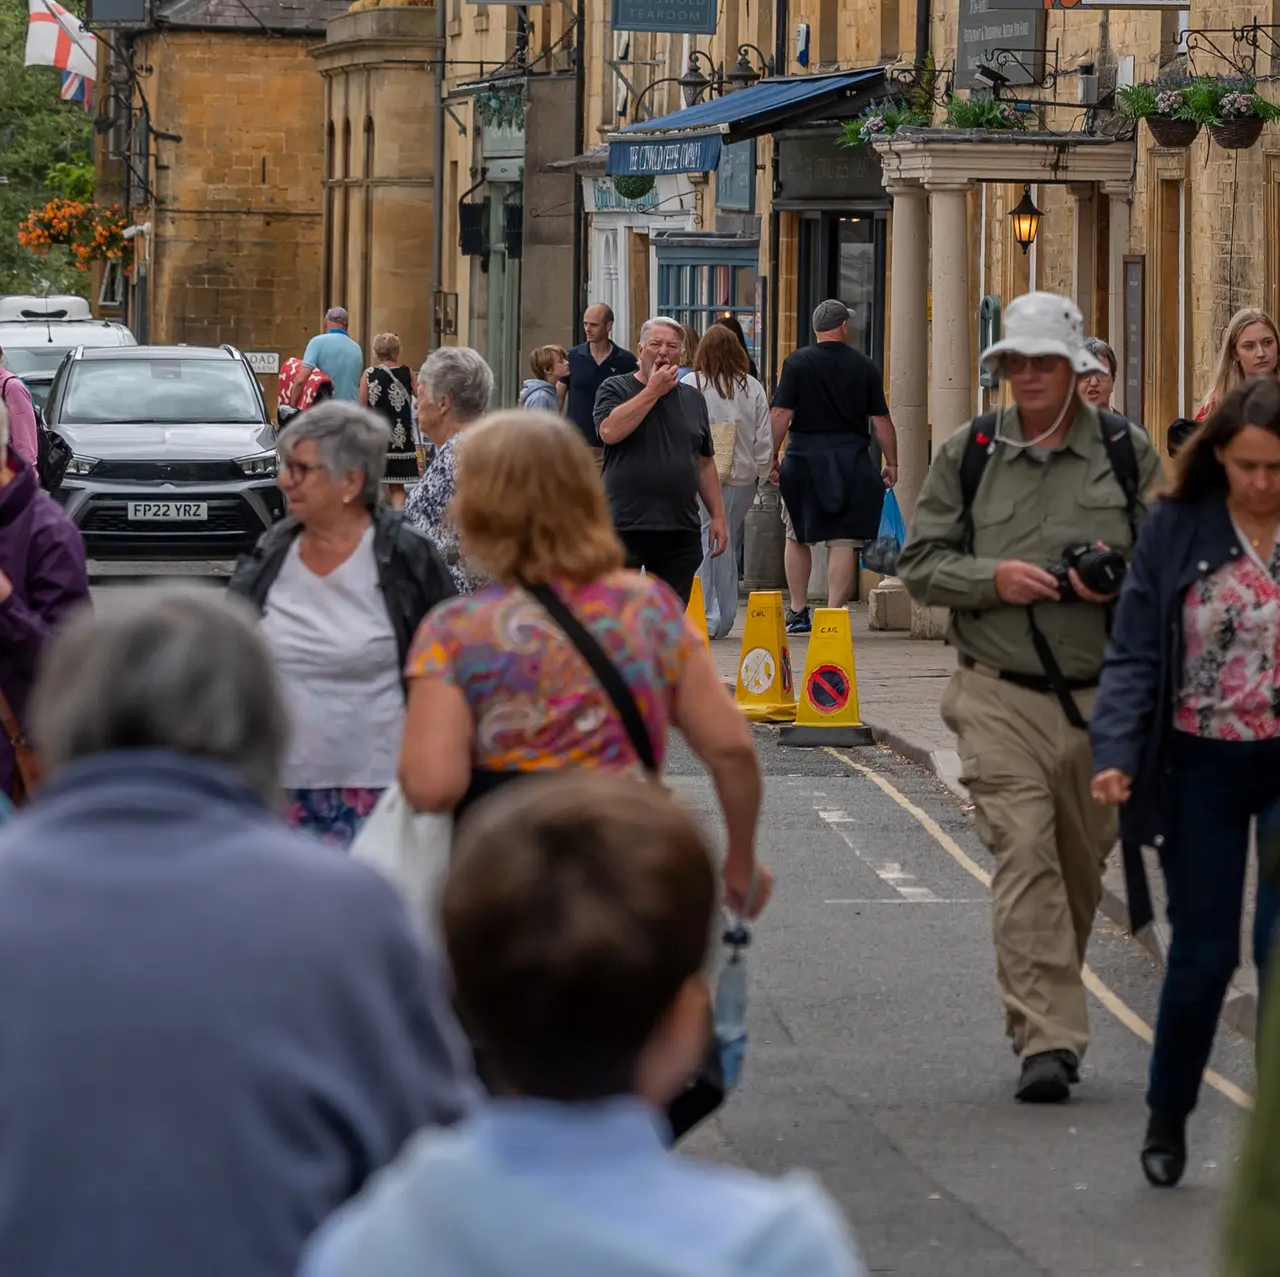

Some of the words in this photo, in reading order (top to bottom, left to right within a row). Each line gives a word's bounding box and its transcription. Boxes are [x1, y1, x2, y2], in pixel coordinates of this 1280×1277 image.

[629, 8, 701, 21] TEAROOM
[250, 354, 276, 365] OAD
[134, 503, 170, 517] FP22
[174, 503, 201, 517] YRZ
